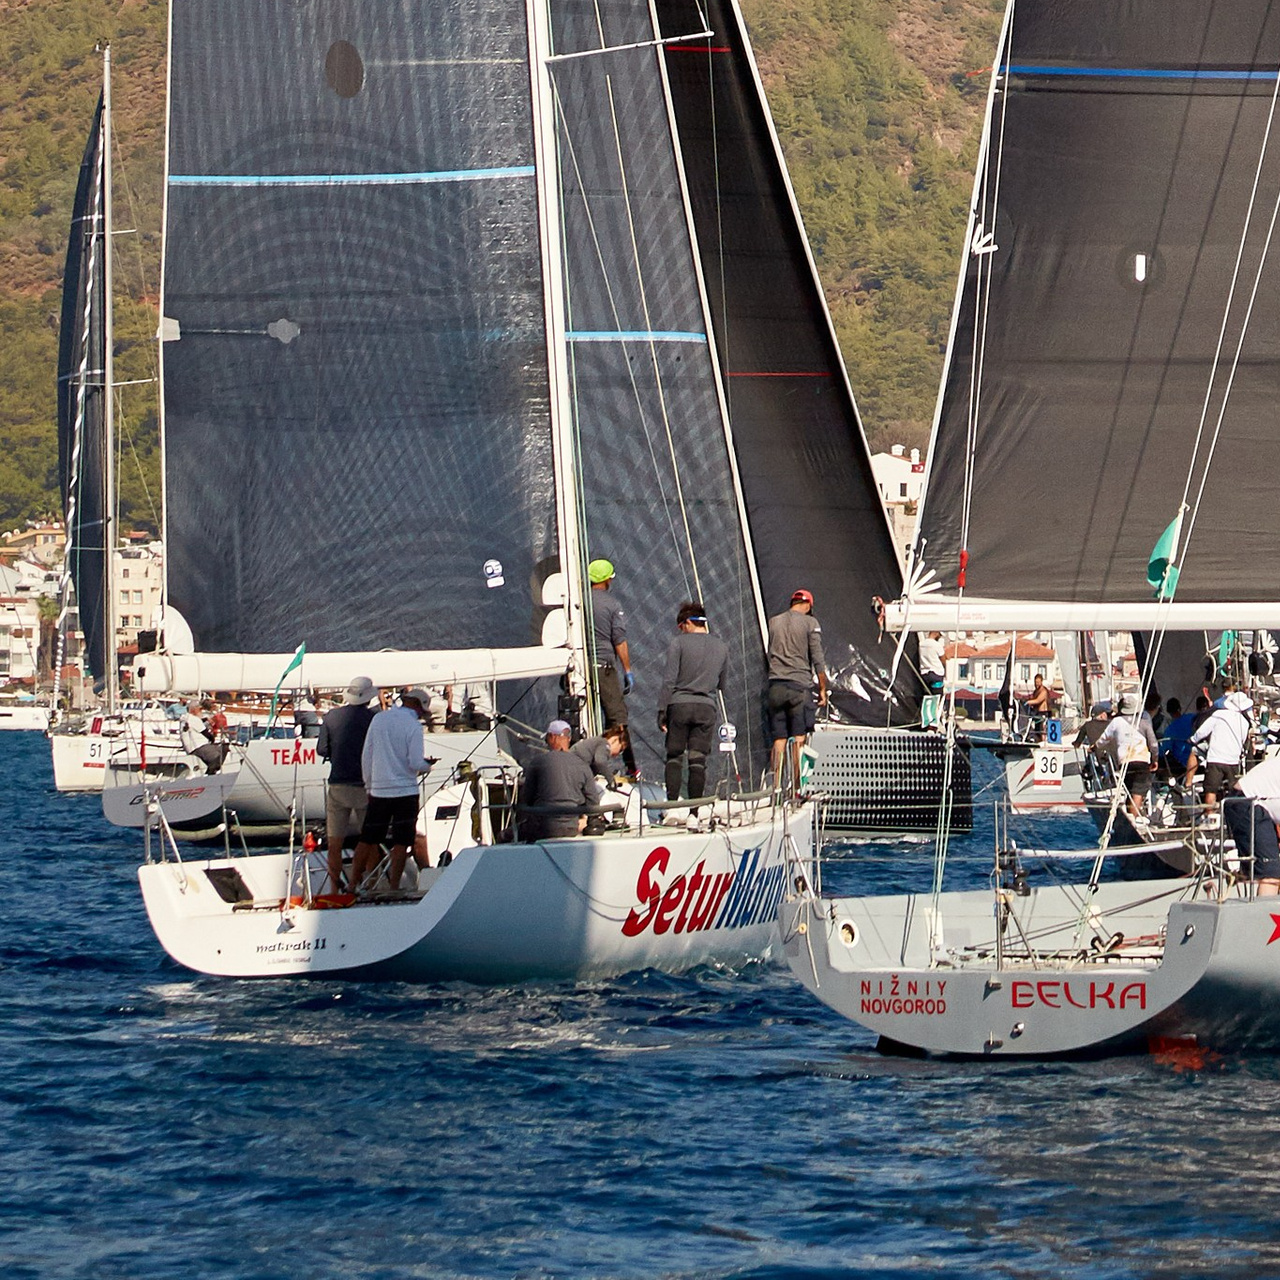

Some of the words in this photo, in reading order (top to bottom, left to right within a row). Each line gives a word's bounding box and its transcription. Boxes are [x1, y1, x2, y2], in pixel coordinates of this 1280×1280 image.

[1049, 723, 1058, 742] 8
[89, 743, 103, 758] 51
[271, 748, 316, 765] TEAM
[1040, 756, 1058, 774] 36
[860, 998, 947, 1015] NOVGOROD
